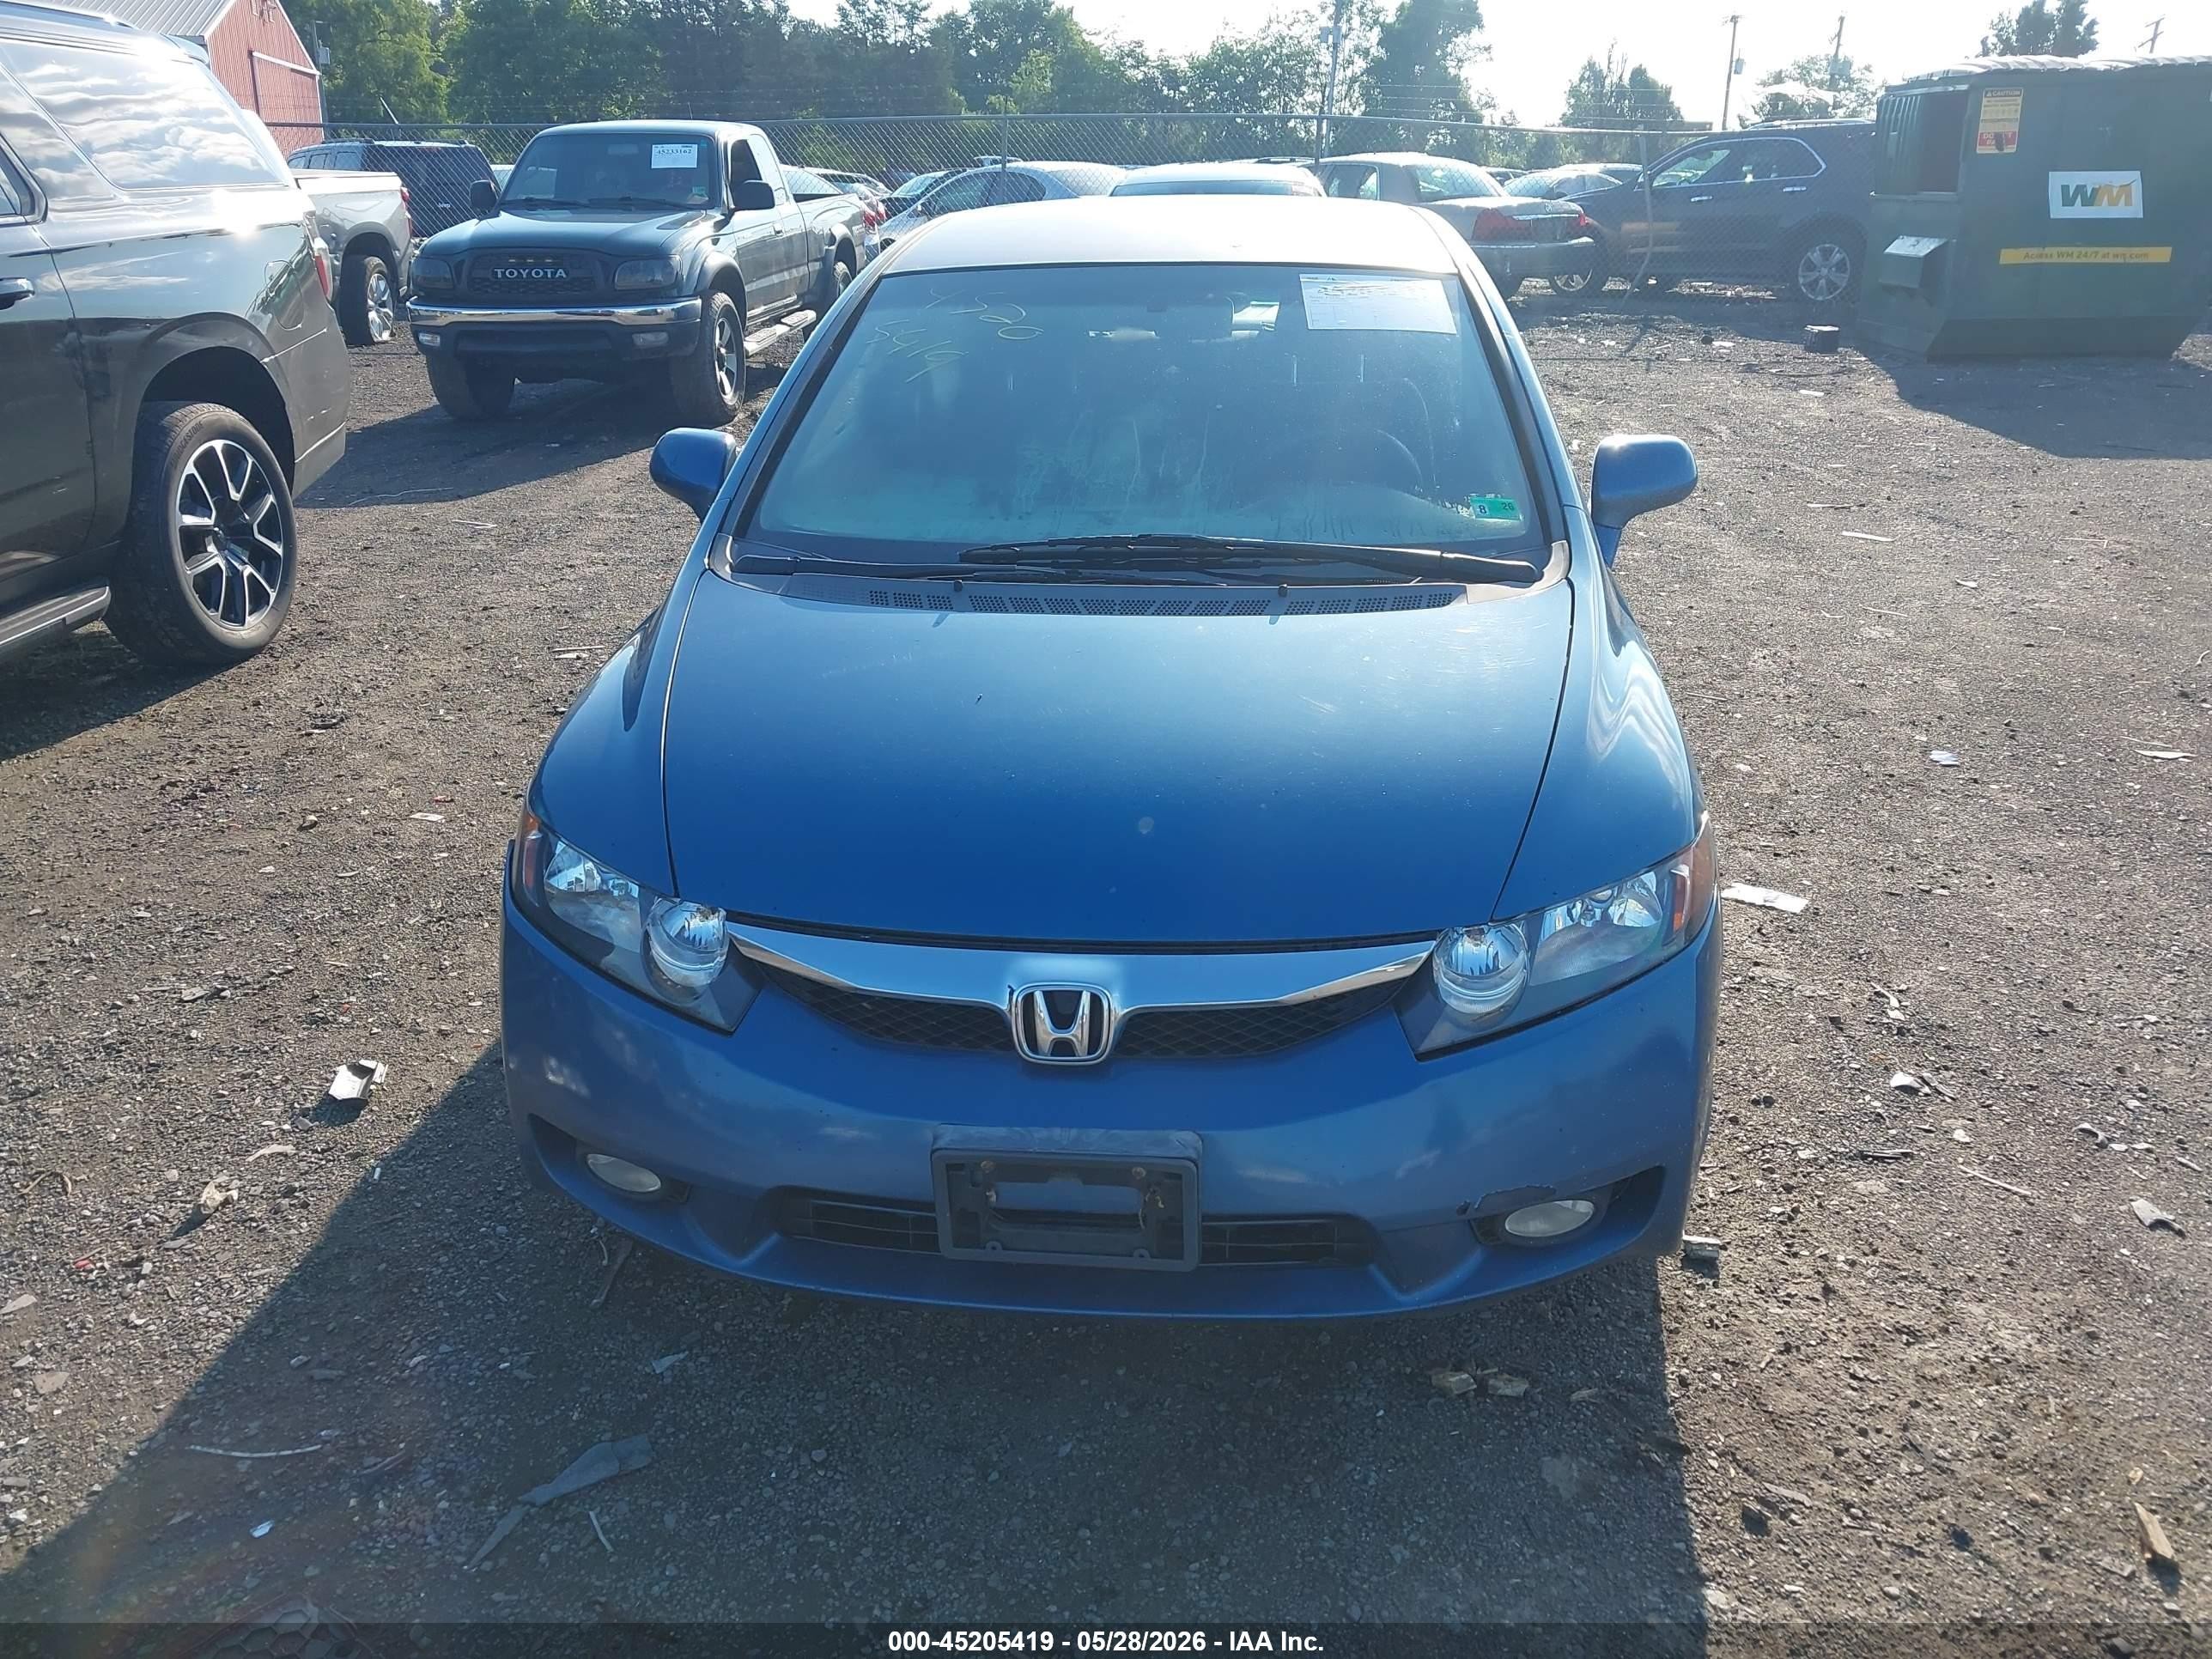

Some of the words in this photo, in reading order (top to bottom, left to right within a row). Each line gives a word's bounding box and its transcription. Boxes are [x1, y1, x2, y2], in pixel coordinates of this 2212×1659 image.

[2061, 184, 2133, 207] WM
[494, 268, 567, 278] TOYOTA
[1479, 504, 1487, 514] 8
